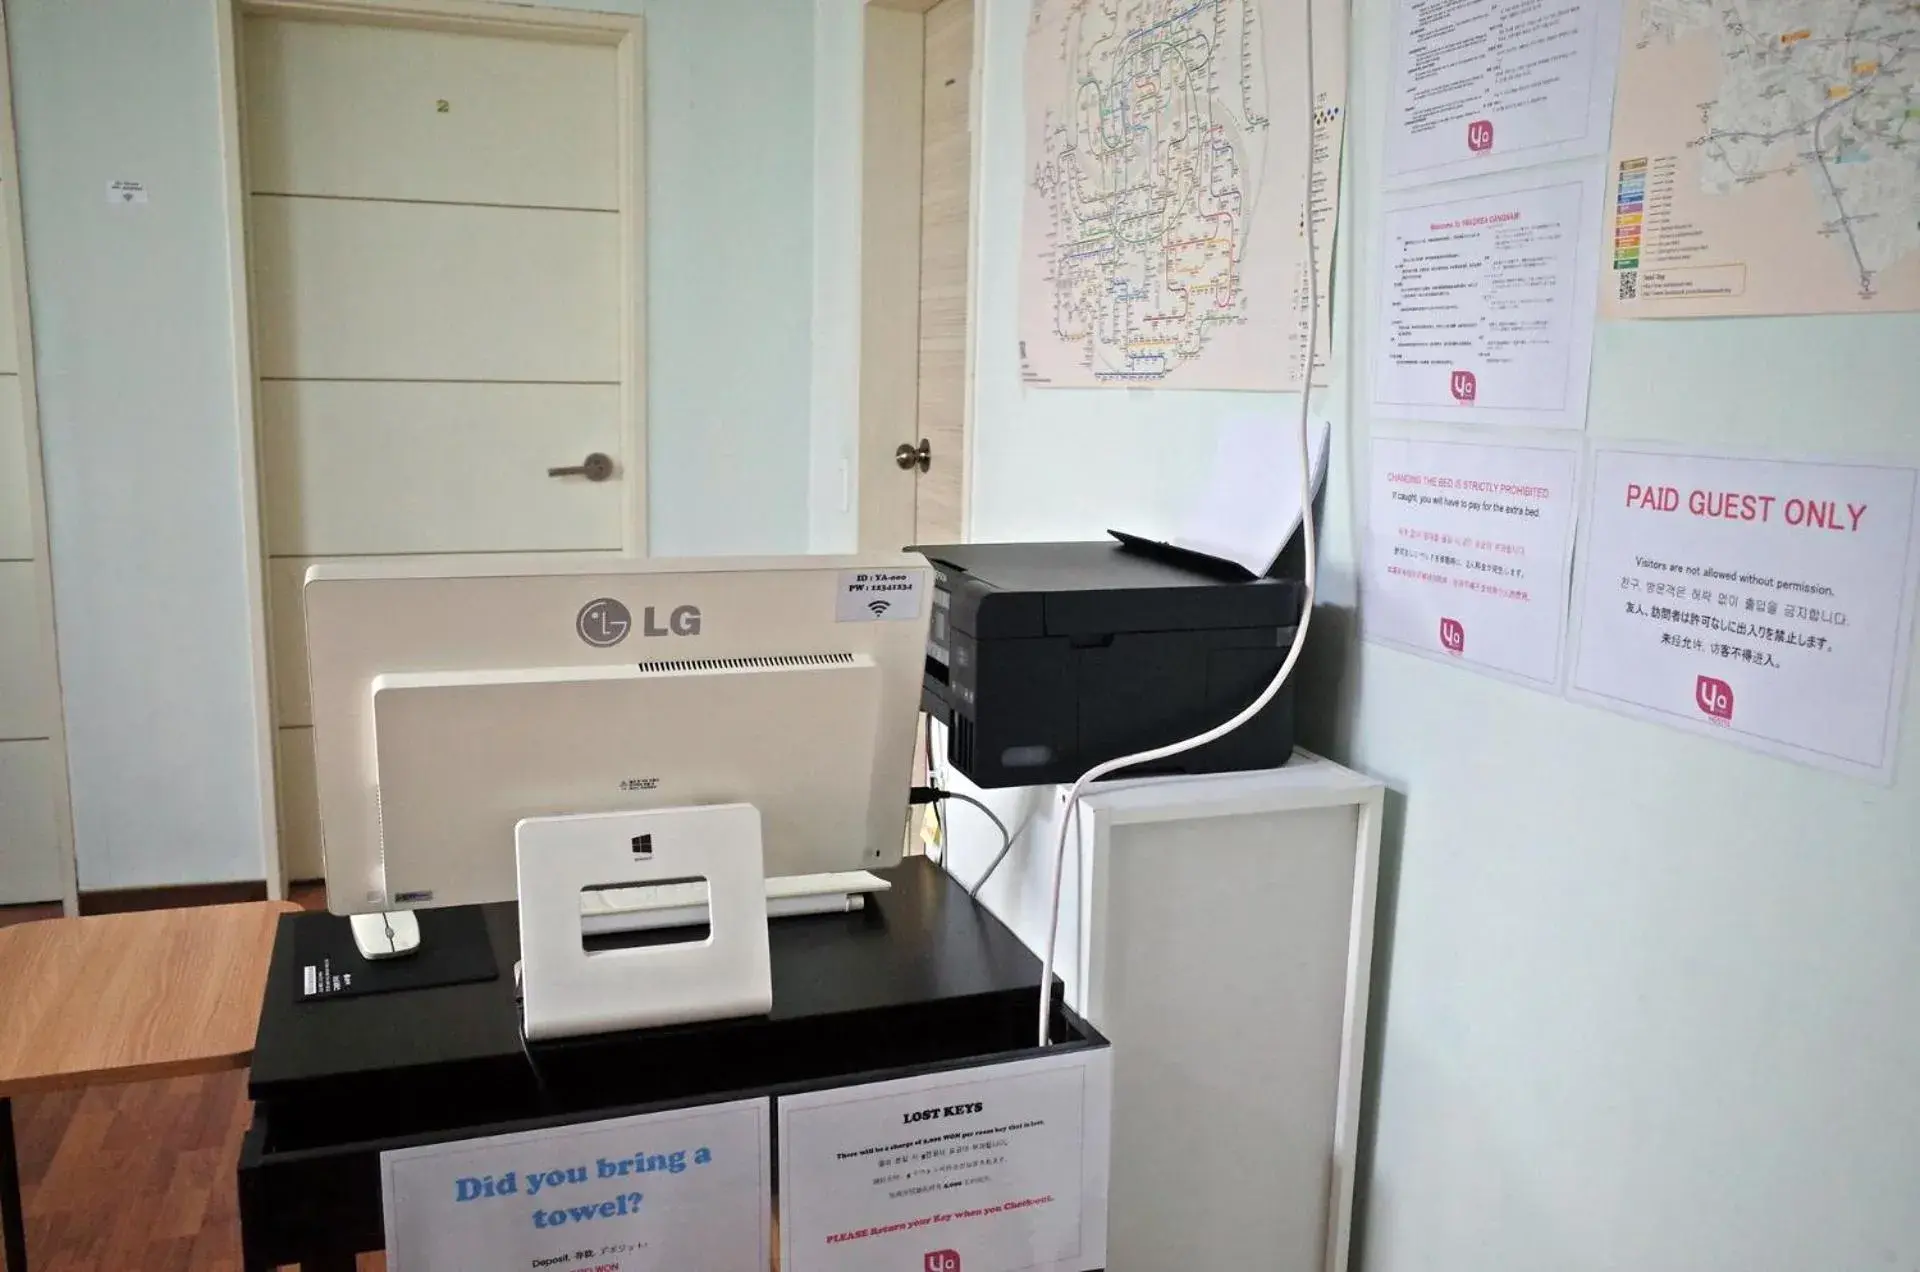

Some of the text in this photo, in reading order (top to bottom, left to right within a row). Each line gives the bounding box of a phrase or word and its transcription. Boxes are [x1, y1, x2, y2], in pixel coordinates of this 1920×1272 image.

[436, 99, 449, 113] 2
[1424, 475, 1437, 486] THE
[1438, 477, 1453, 488] BED
[1454, 479, 1462, 489] IS
[1463, 480, 1498, 493] STRICTLY
[1500, 483, 1549, 498] PROHIBITED
[1419, 496, 1431, 505] you
[1432, 496, 1443, 505] will
[1444, 497, 1459, 507] have
[1461, 499, 1467, 508] to
[1468, 502, 1481, 512] pay
[1482, 501, 1492, 511] for
[1493, 503, 1503, 513] the
[1506, 506, 1523, 515] extra
[1626, 484, 1867, 532] PAID GUEST ONLY
[848, 584, 865, 592] PW
[856, 574, 868, 582] ID
[1635, 556, 1835, 597] Visitors are not allowed without permission.
[643, 605, 702, 637] LG
[902, 1101, 984, 1125] LOST KEYS
[836, 1151, 858, 1160] There
[859, 1147, 873, 1157] will
[890, 1142, 913, 1153] charge
[914, 1139, 922, 1147] of
[943, 1132, 961, 1140] WON
[962, 1132, 974, 1140] per
[975, 1129, 994, 1137] room
[995, 1126, 1007, 1135] key
[1008, 1122, 1023, 1131] that
[455, 1146, 712, 1202] Did you bring a
[532, 1191, 645, 1229] towel?
[826, 1228, 868, 1244] PLEASE
[869, 1222, 906, 1236] Return
[907, 1217, 931, 1230] your
[932, 1212, 952, 1224] Key
[954, 1209, 982, 1220] when
[984, 1205, 1003, 1217] you
